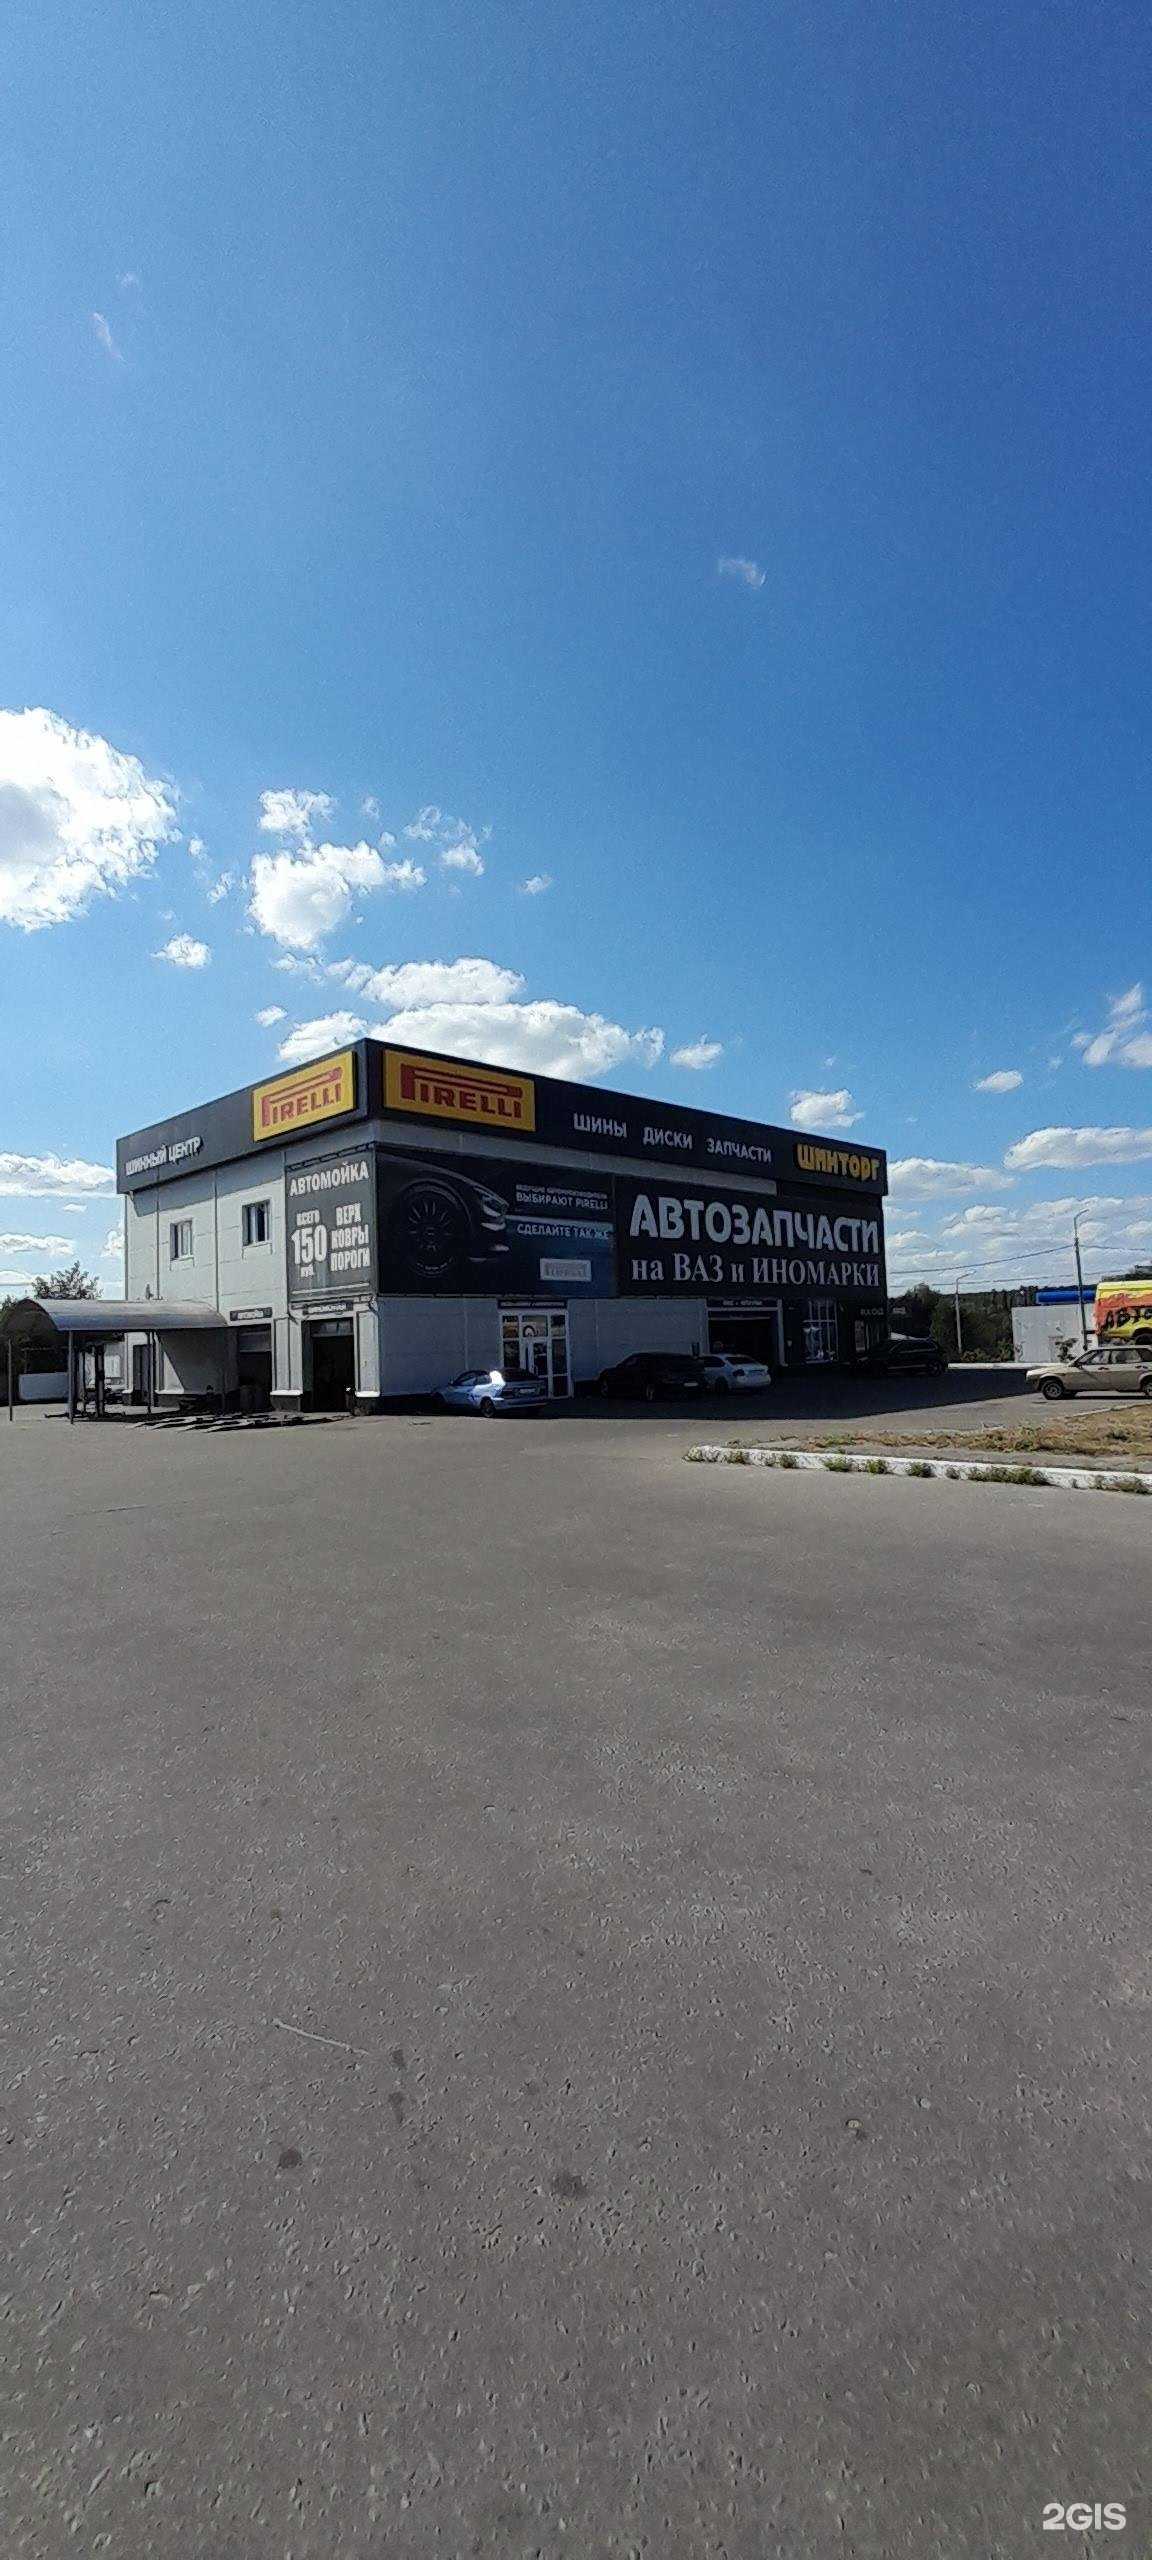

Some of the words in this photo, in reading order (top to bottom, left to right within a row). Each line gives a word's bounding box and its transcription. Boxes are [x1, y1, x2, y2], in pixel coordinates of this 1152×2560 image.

[262, 1067, 343, 1128] PIRELLI
[401, 1063, 523, 1118] PIRELLI
[126, 1144, 167, 1176] ШИННЫЙ
[168, 1136, 201, 1162] ЦЕНТР
[573, 1113, 627, 1138] ШИНЫ
[642, 1127, 693, 1149] ДИСКИ
[706, 1138, 772, 1163] ЗАПЧАСТИ
[289, 1161, 369, 1197] АВТОМОЙКА
[797, 1144, 880, 1181] ШИНТОРГ
[297, 1209, 320, 1226] ВСЕГО
[336, 1203, 361, 1226] ВЕРХ
[516, 1191, 573, 1207] ВЫБИРАЮТ
[576, 1198, 608, 1210] PIRELLI
[331, 1224, 369, 1250] КОВРЫ
[517, 1223, 571, 1237] СДЕЛАЙТЕ
[573, 1227, 592, 1239] ТАК
[630, 1194, 879, 1253] АВТОЗАПЧАСТИ
[291, 1224, 327, 1265] 150
[331, 1247, 370, 1272] ПОРОГИ
[632, 1258, 664, 1281] на
[673, 1253, 723, 1283] ВАЗ
[730, 1264, 744, 1283] и
[752, 1257, 880, 1288] ИНОМАРКИ
